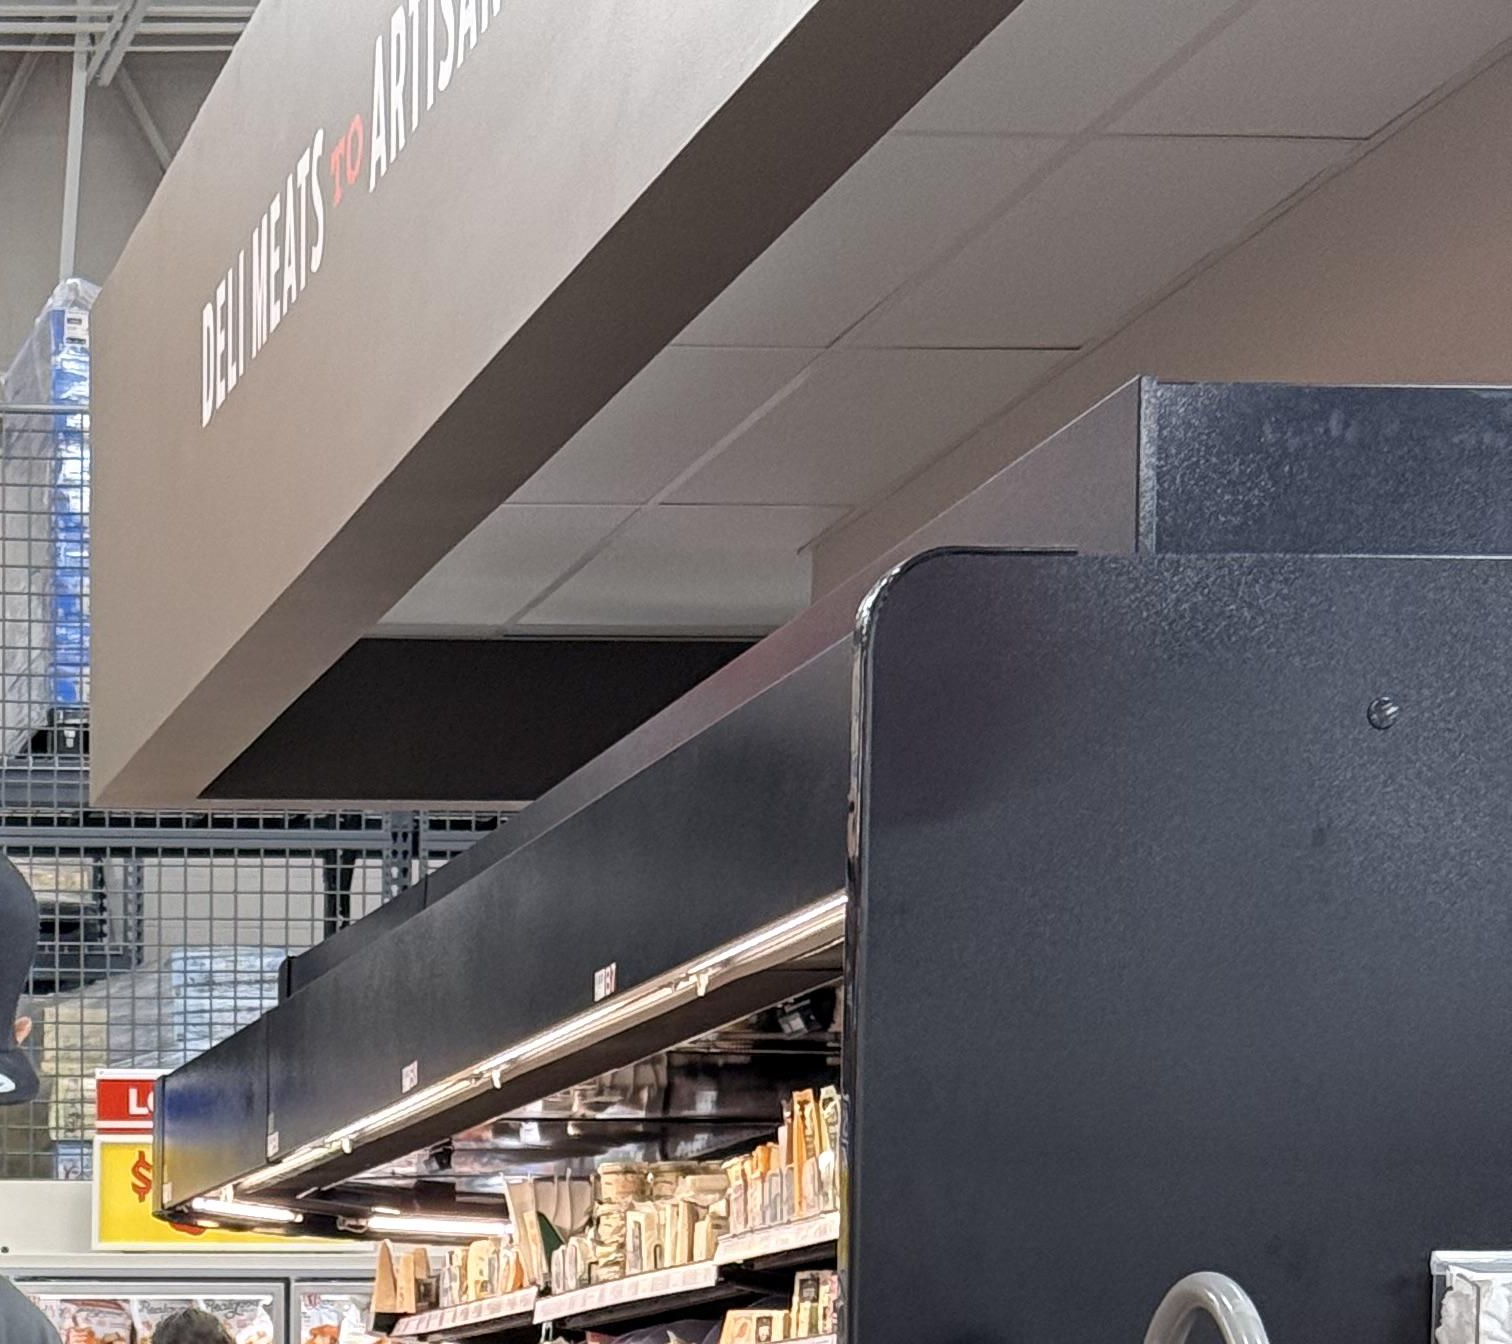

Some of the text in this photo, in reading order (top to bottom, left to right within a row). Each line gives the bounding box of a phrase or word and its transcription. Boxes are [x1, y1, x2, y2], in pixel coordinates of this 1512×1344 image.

[202, 248, 246, 429] DELI
[251, 128, 325, 360] MEATS
[330, 113, 364, 208] TO
[128, 1087, 155, 1115] L
